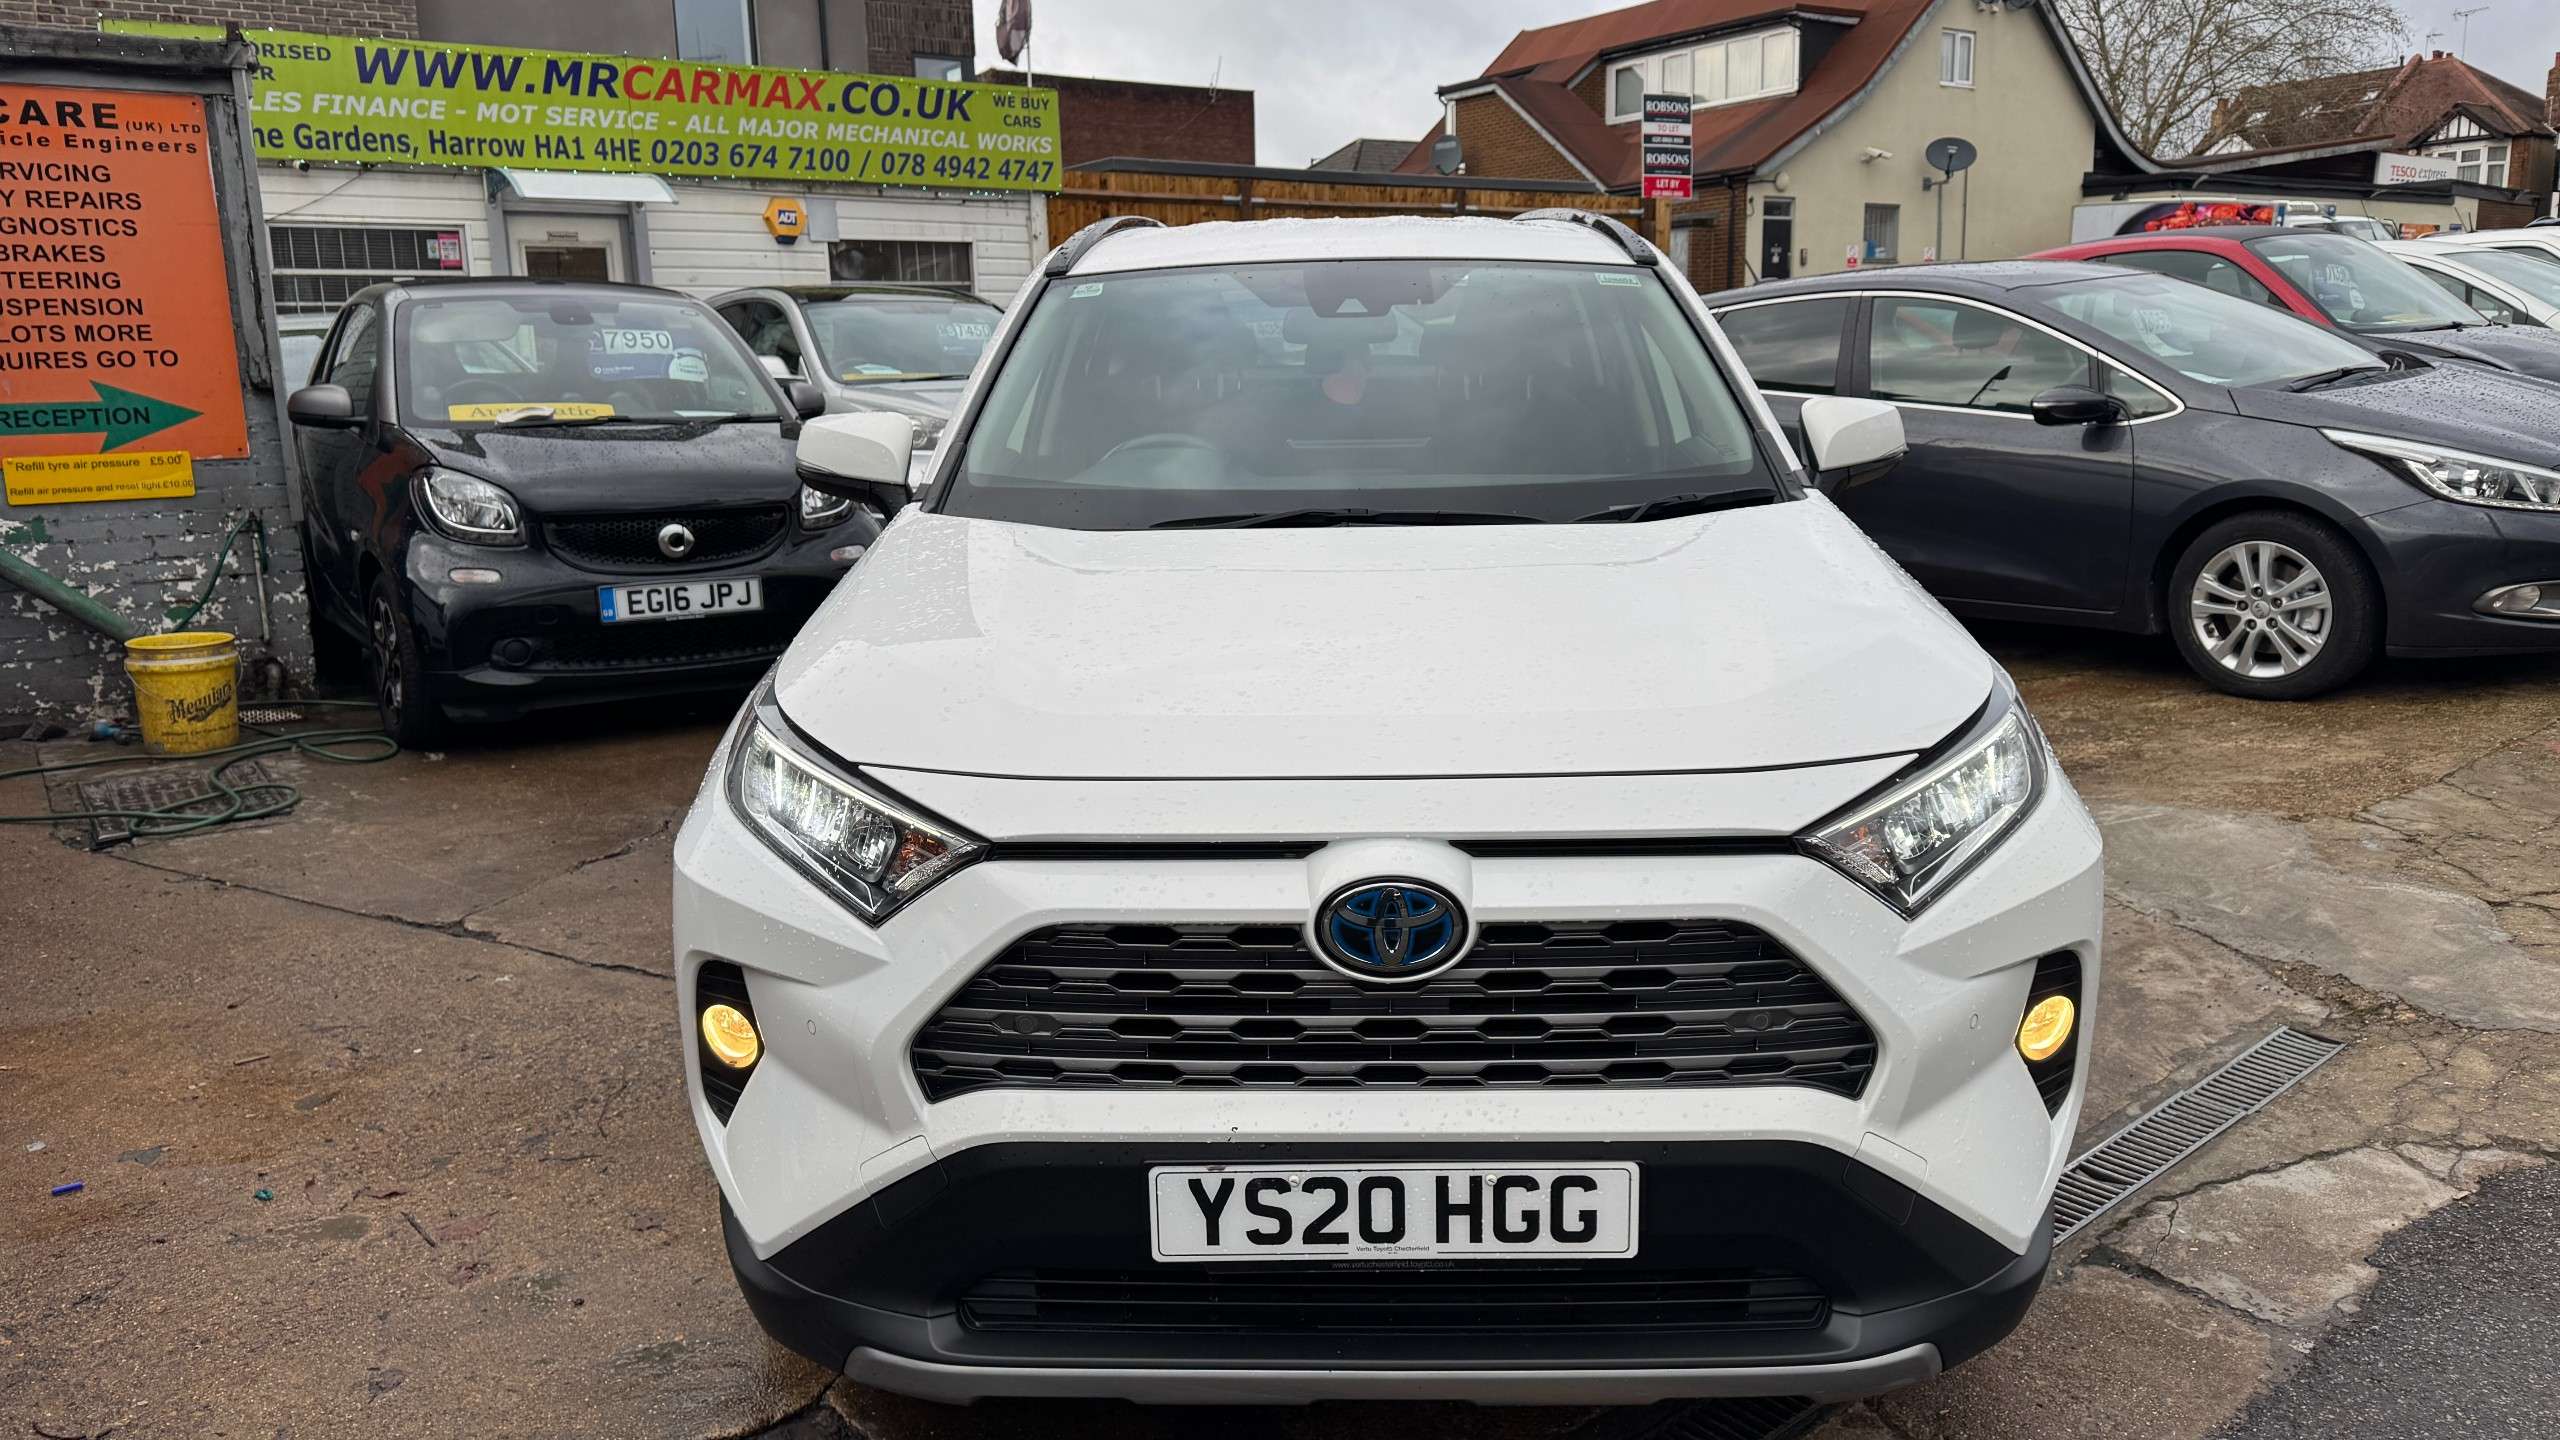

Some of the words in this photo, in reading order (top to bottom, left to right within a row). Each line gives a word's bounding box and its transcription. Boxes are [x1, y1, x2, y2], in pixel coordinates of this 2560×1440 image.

[254, 66, 276, 81] R
[354, 46, 974, 122] WWW.MRCARMAX.CO.UK
[992, 95, 1015, 108] WE
[1021, 97, 1049, 111] BUY
[1646, 101, 1689, 113] ROBSONS
[125, 121, 163, 134] (UK)
[170, 122, 201, 134] LTD
[312, 93, 446, 120] FINANCE
[477, 102, 538, 124] MOT
[545, 106, 659, 130] SERVICE
[685, 114, 729, 134] ALL
[738, 117, 818, 140] MAJOR
[827, 123, 970, 149] MECHANICAL
[978, 132, 1053, 154] WORKS
[1003, 114, 1041, 129] CARS
[0, 130, 50, 147] icle
[64, 134, 198, 154] Engineers
[293, 123, 419, 159] Gardens,
[429, 129, 525, 158] Harrow
[535, 134, 584, 160] HA1
[594, 137, 641, 163] 4HE
[651, 139, 719, 166] 0203
[729, 144, 778, 169] 674
[788, 146, 849, 172] 7100
[858, 150, 872, 177] /
[881, 152, 925, 176] 078
[933, 155, 990, 180] 4942
[998, 159, 1054, 183] 4747
[1646, 153, 1689, 165] ROBSONS
[0, 162, 111, 183] RVICING
[2390, 165, 2416, 178] TESCO
[1656, 179, 1668, 188] LET
[0, 189, 15, 207] Y
[25, 190, 142, 211] REPAIRS
[0, 217, 138, 236] GNOSTICS
[778, 211, 796, 224] ADT
[0, 244, 106, 263] BRAKES
[1, 271, 121, 289] TEERING
[0, 298, 143, 316] SPENSION
[75, 324, 152, 342] MORE
[604, 331, 670, 349] 7950
[97, 350, 136, 368] GO
[143, 350, 178, 367] TO
[0, 407, 151, 428] RECEPTION
[15, 461, 44, 472] Refill
[48, 462, 70, 474] tyre
[73, 460, 87, 470] air
[91, 458, 140, 471] pressure
[10, 486, 34, 496] Refill
[37, 485, 49, 495] air
[52, 485, 93, 496] pressure
[96, 483, 113, 492] and
[626, 586, 691, 615] EG16
[700, 581, 751, 609] JPJ
[1187, 1175, 1406, 1247] YS20
[1435, 1175, 1597, 1244] HGG
[1373, 1245, 1393, 1253] Toyota
